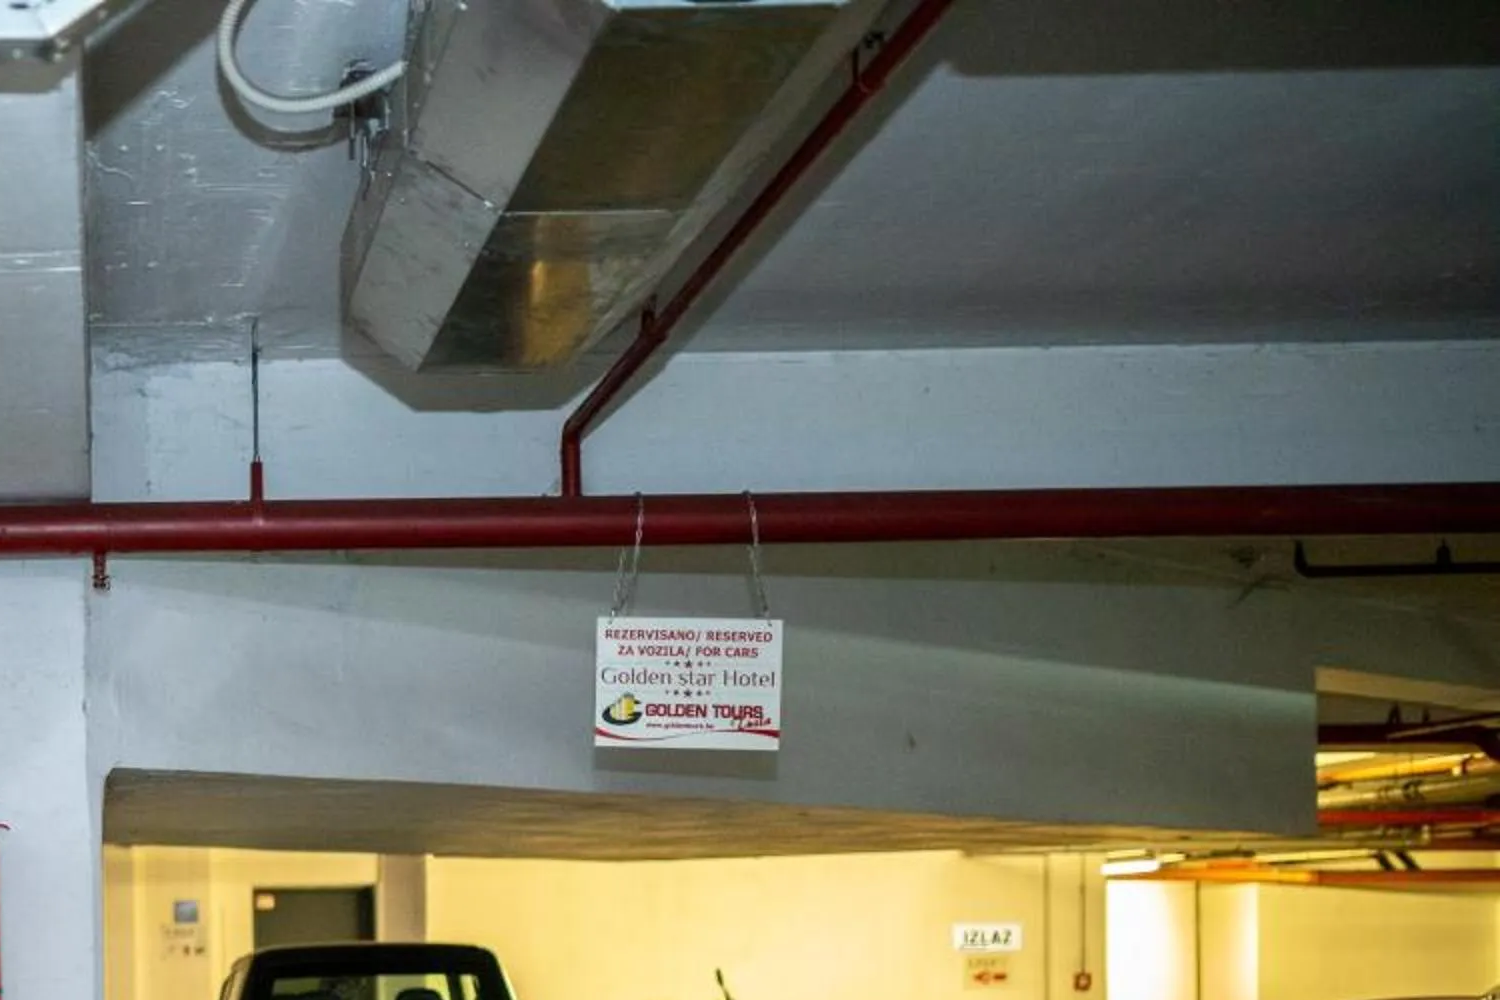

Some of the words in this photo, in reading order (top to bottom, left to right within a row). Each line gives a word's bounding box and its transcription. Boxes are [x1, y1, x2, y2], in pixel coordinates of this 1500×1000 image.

[605, 629, 700, 643] REZERVISANO/
[706, 630, 773, 643] RESERVED
[618, 645, 635, 656] ZA
[637, 646, 691, 659] VOZILA/
[695, 647, 721, 657] FOR
[725, 647, 759, 658] CARS
[601, 666, 672, 685] Golden
[679, 669, 716, 687] star
[723, 669, 775, 688] Hotel
[645, 703, 707, 718] GOLDEN
[711, 704, 764, 720] TOURS
[963, 929, 1013, 945] IZLAZ
